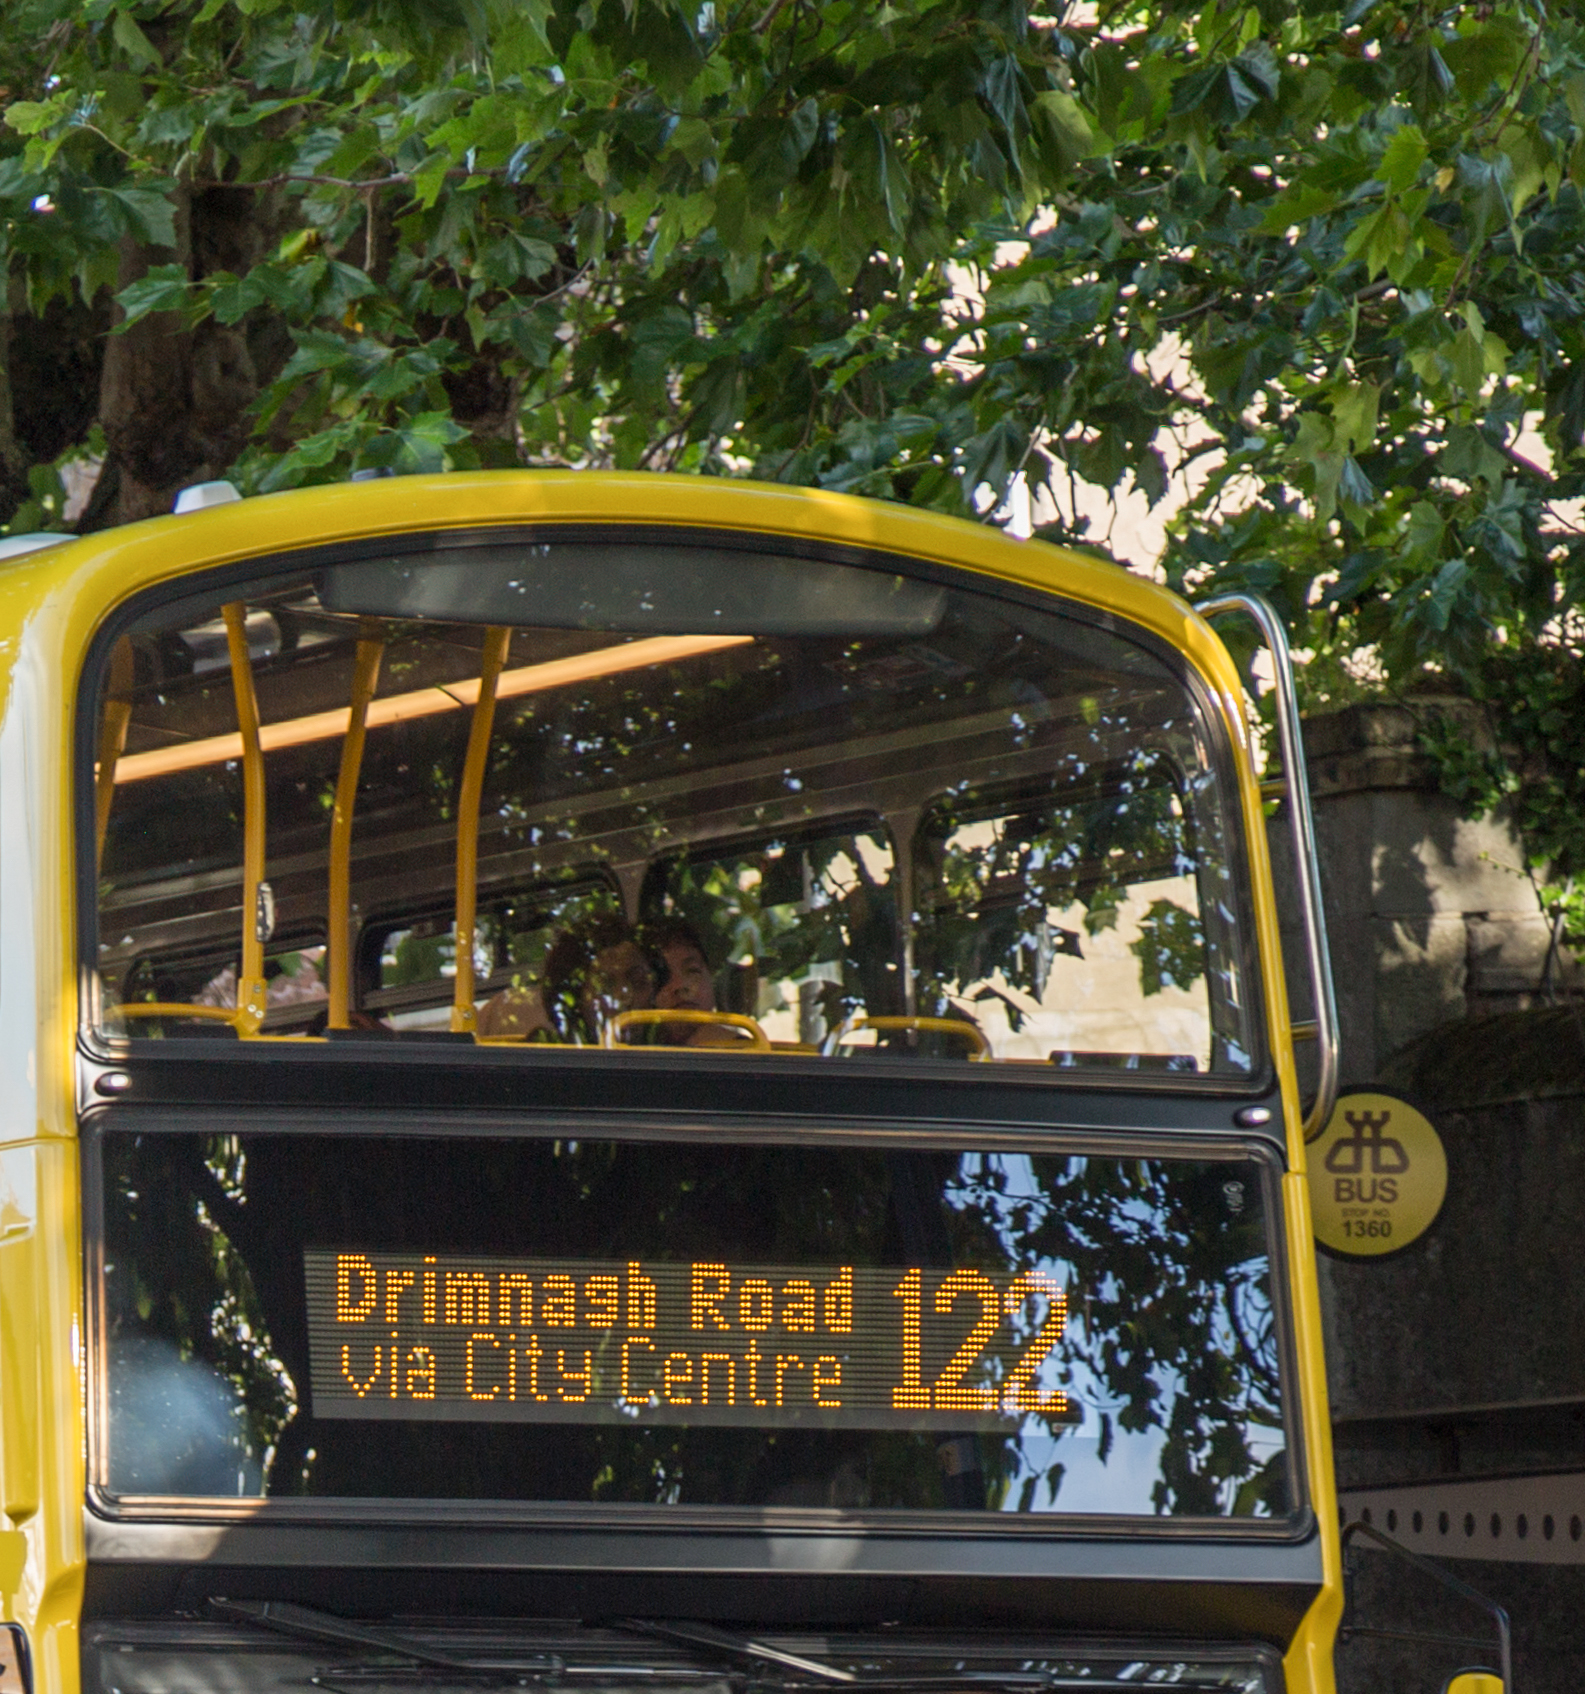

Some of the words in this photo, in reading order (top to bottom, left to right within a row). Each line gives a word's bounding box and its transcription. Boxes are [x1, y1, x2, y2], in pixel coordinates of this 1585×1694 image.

[1334, 1178, 1399, 1203] BUS
[1343, 1220, 1392, 1238] 1360
[336, 1254, 657, 1330] Drimnagh
[691, 1262, 853, 1332] Road
[892, 1267, 1068, 1413] 122
[340, 1331, 436, 1400] via
[465, 1332, 592, 1403] City
[620, 1336, 843, 1408] Centre
